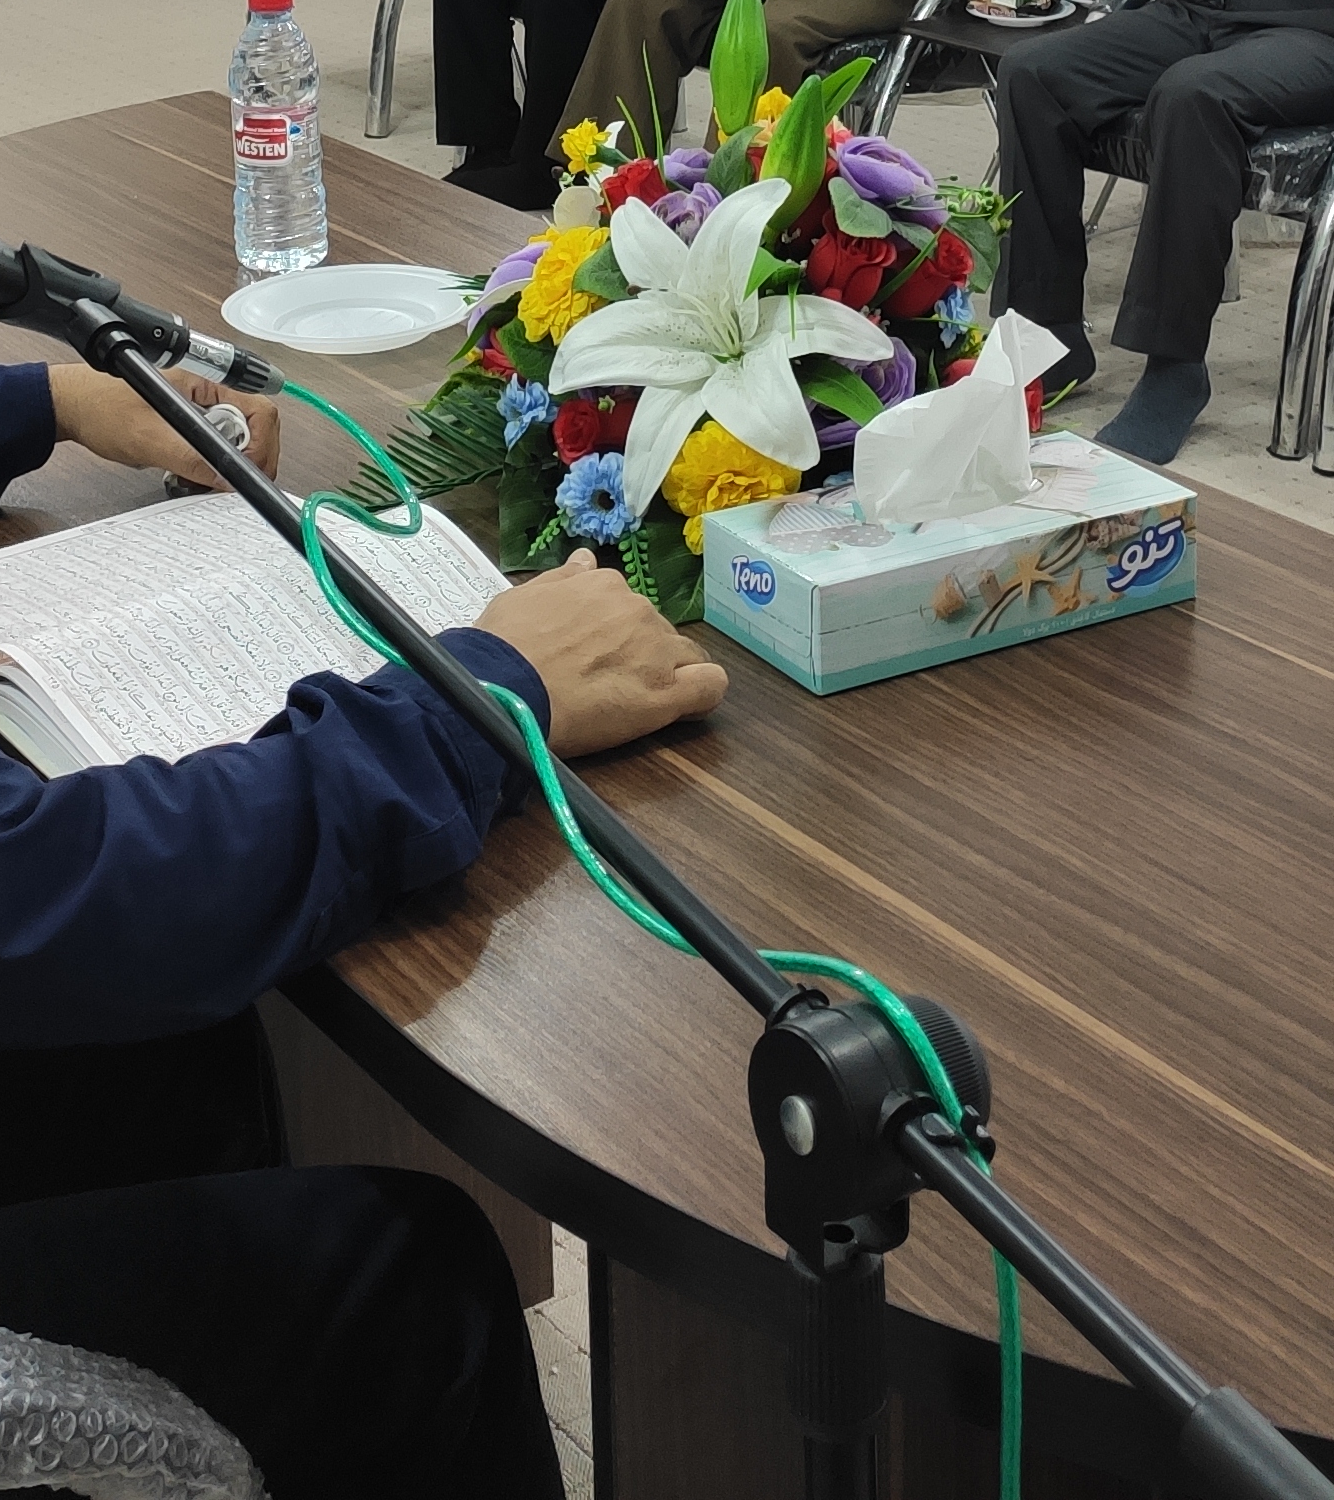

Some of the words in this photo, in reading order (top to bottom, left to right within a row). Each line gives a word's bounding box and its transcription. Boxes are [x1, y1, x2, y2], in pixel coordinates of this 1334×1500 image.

[236, 136, 286, 156] WESTEN
[1110, 519, 1182, 589] تنو
[732, 556, 772, 592] Teno
